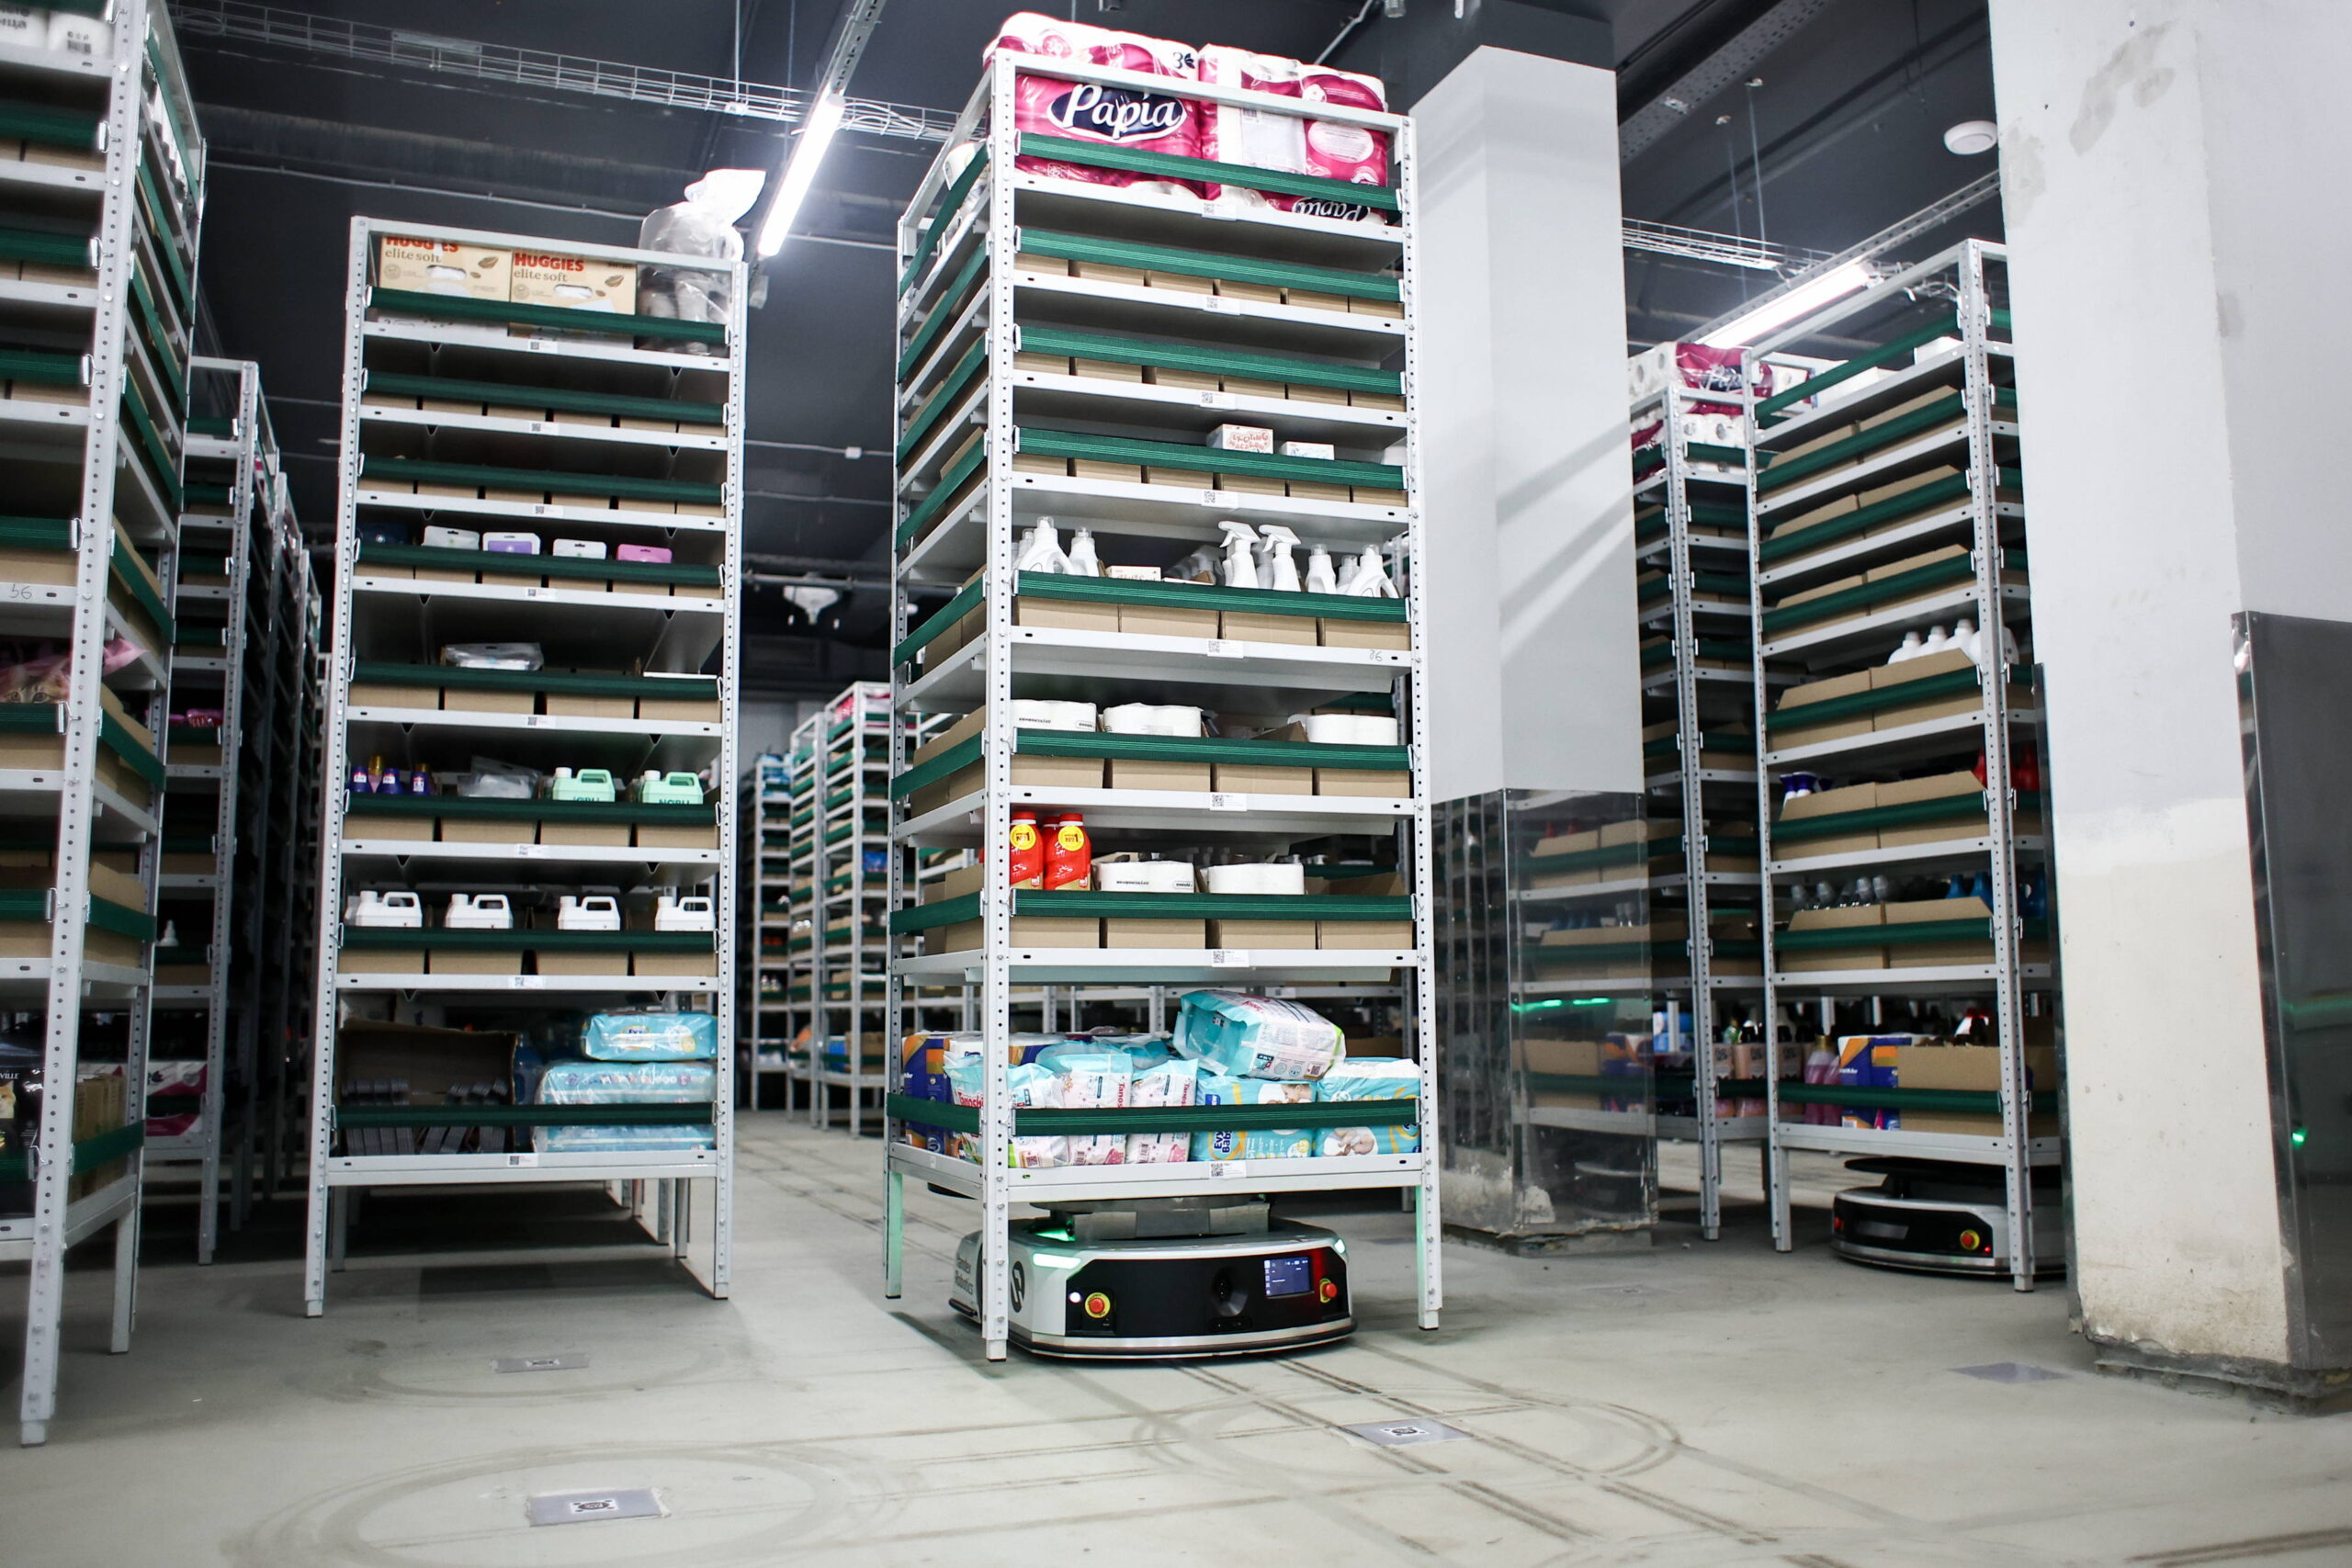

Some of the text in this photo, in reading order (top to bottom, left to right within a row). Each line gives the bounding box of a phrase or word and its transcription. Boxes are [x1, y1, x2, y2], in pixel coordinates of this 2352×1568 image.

[1062, 84, 1182, 140] Papia
[385, 248, 414, 261] elite
[514, 253, 585, 272] HUGGIES
[514, 269, 569, 282] elite soft
[1117, 1083, 1125, 1109] Tanos
[1181, 1083, 1191, 1107] Tanos
[1222, 1132, 1231, 1153] Bab
